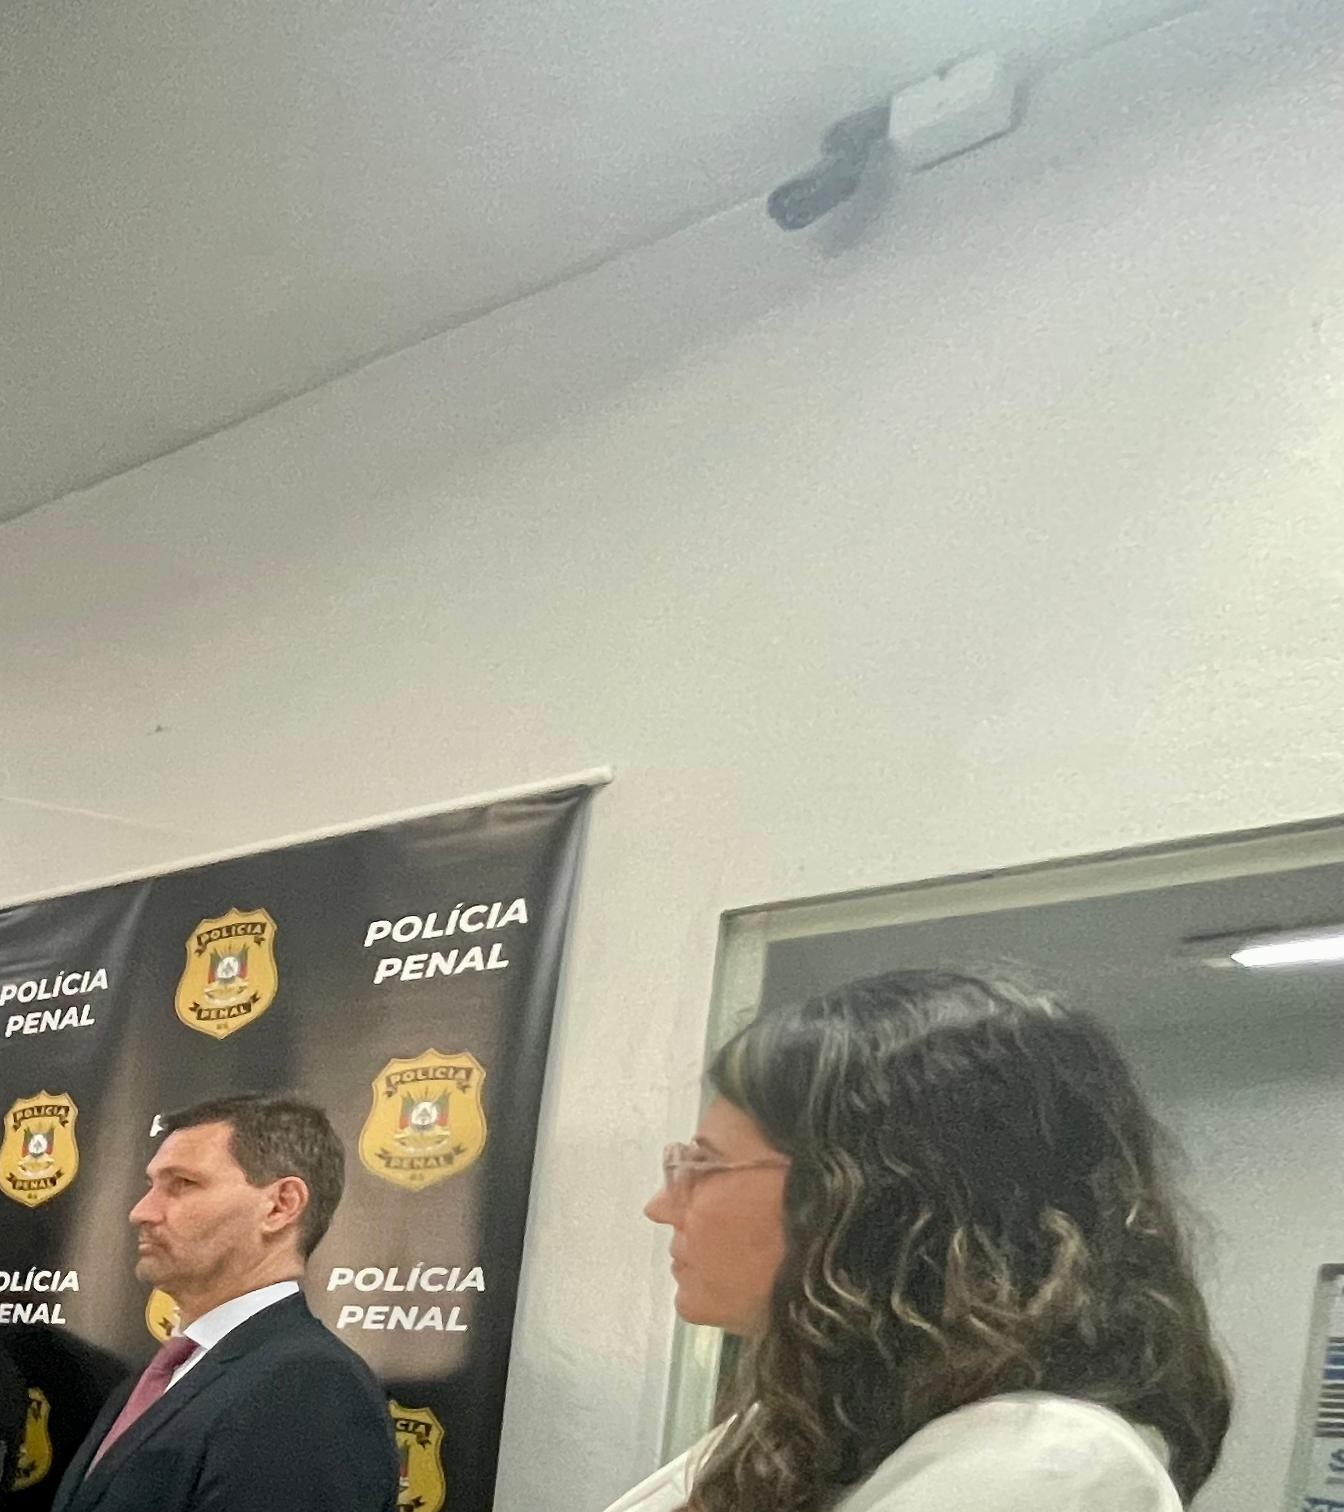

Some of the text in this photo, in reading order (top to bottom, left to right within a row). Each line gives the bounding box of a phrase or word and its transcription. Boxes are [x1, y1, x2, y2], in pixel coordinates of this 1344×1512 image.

[364, 898, 529, 948] POLÍCIA
[373, 942, 510, 985] PENAL
[5, 1004, 96, 1038] PENAL
[327, 1262, 486, 1292] POLÍCIA
[336, 1305, 468, 1331] PENAL
